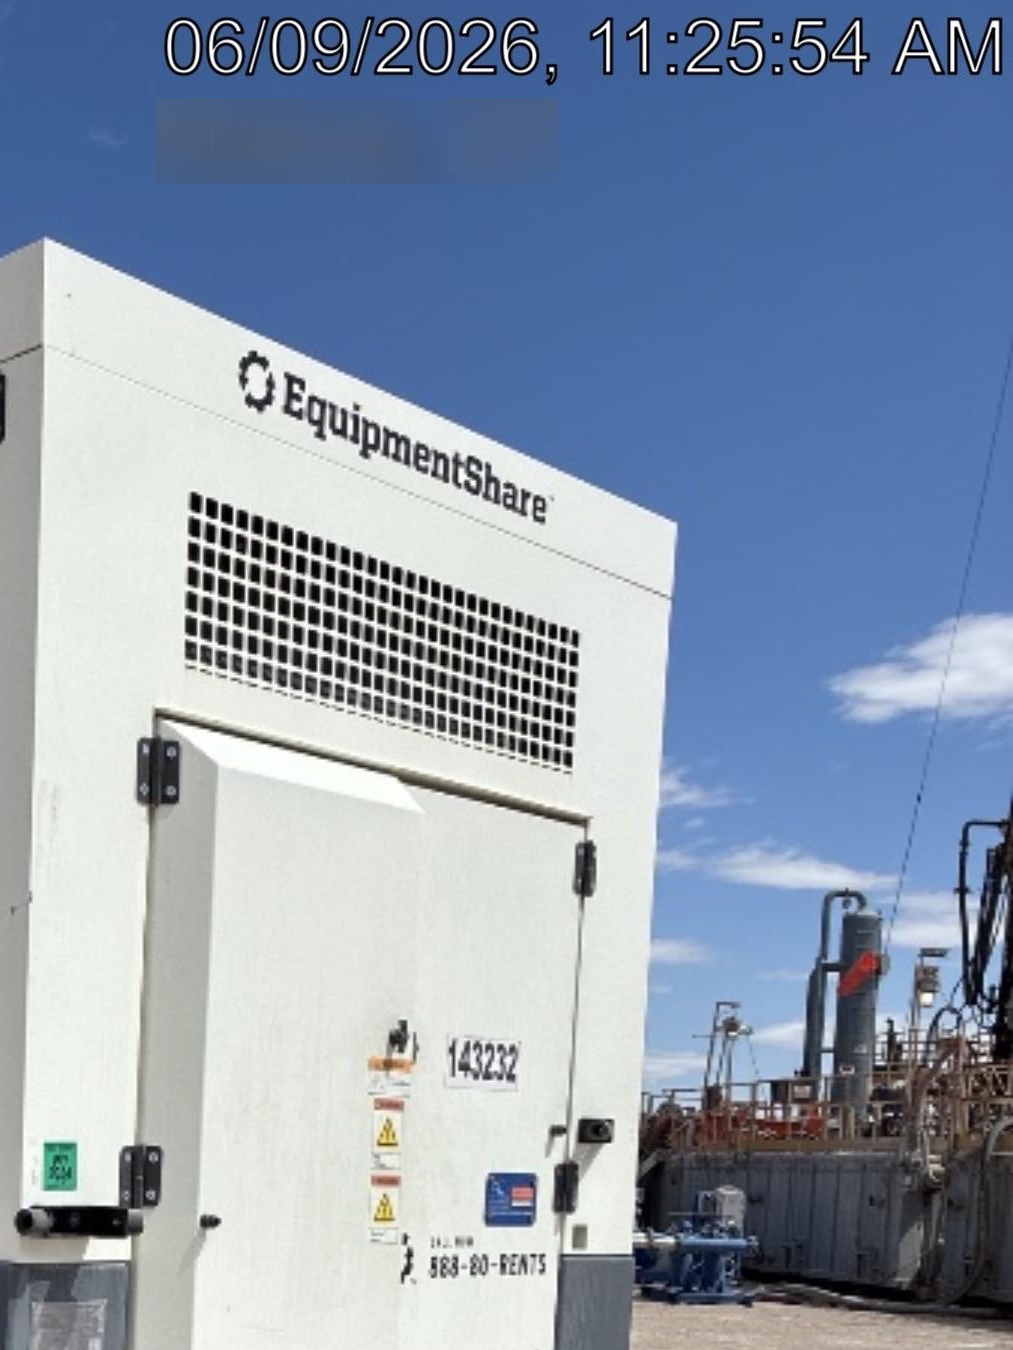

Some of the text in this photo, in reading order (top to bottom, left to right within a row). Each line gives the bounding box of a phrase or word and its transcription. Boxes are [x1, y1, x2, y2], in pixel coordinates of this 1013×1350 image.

[282, 370, 547, 524] EquipmentShare
[447, 1037, 520, 1083] 143232
[429, 1252, 547, 1279] 888-80-RENTS
